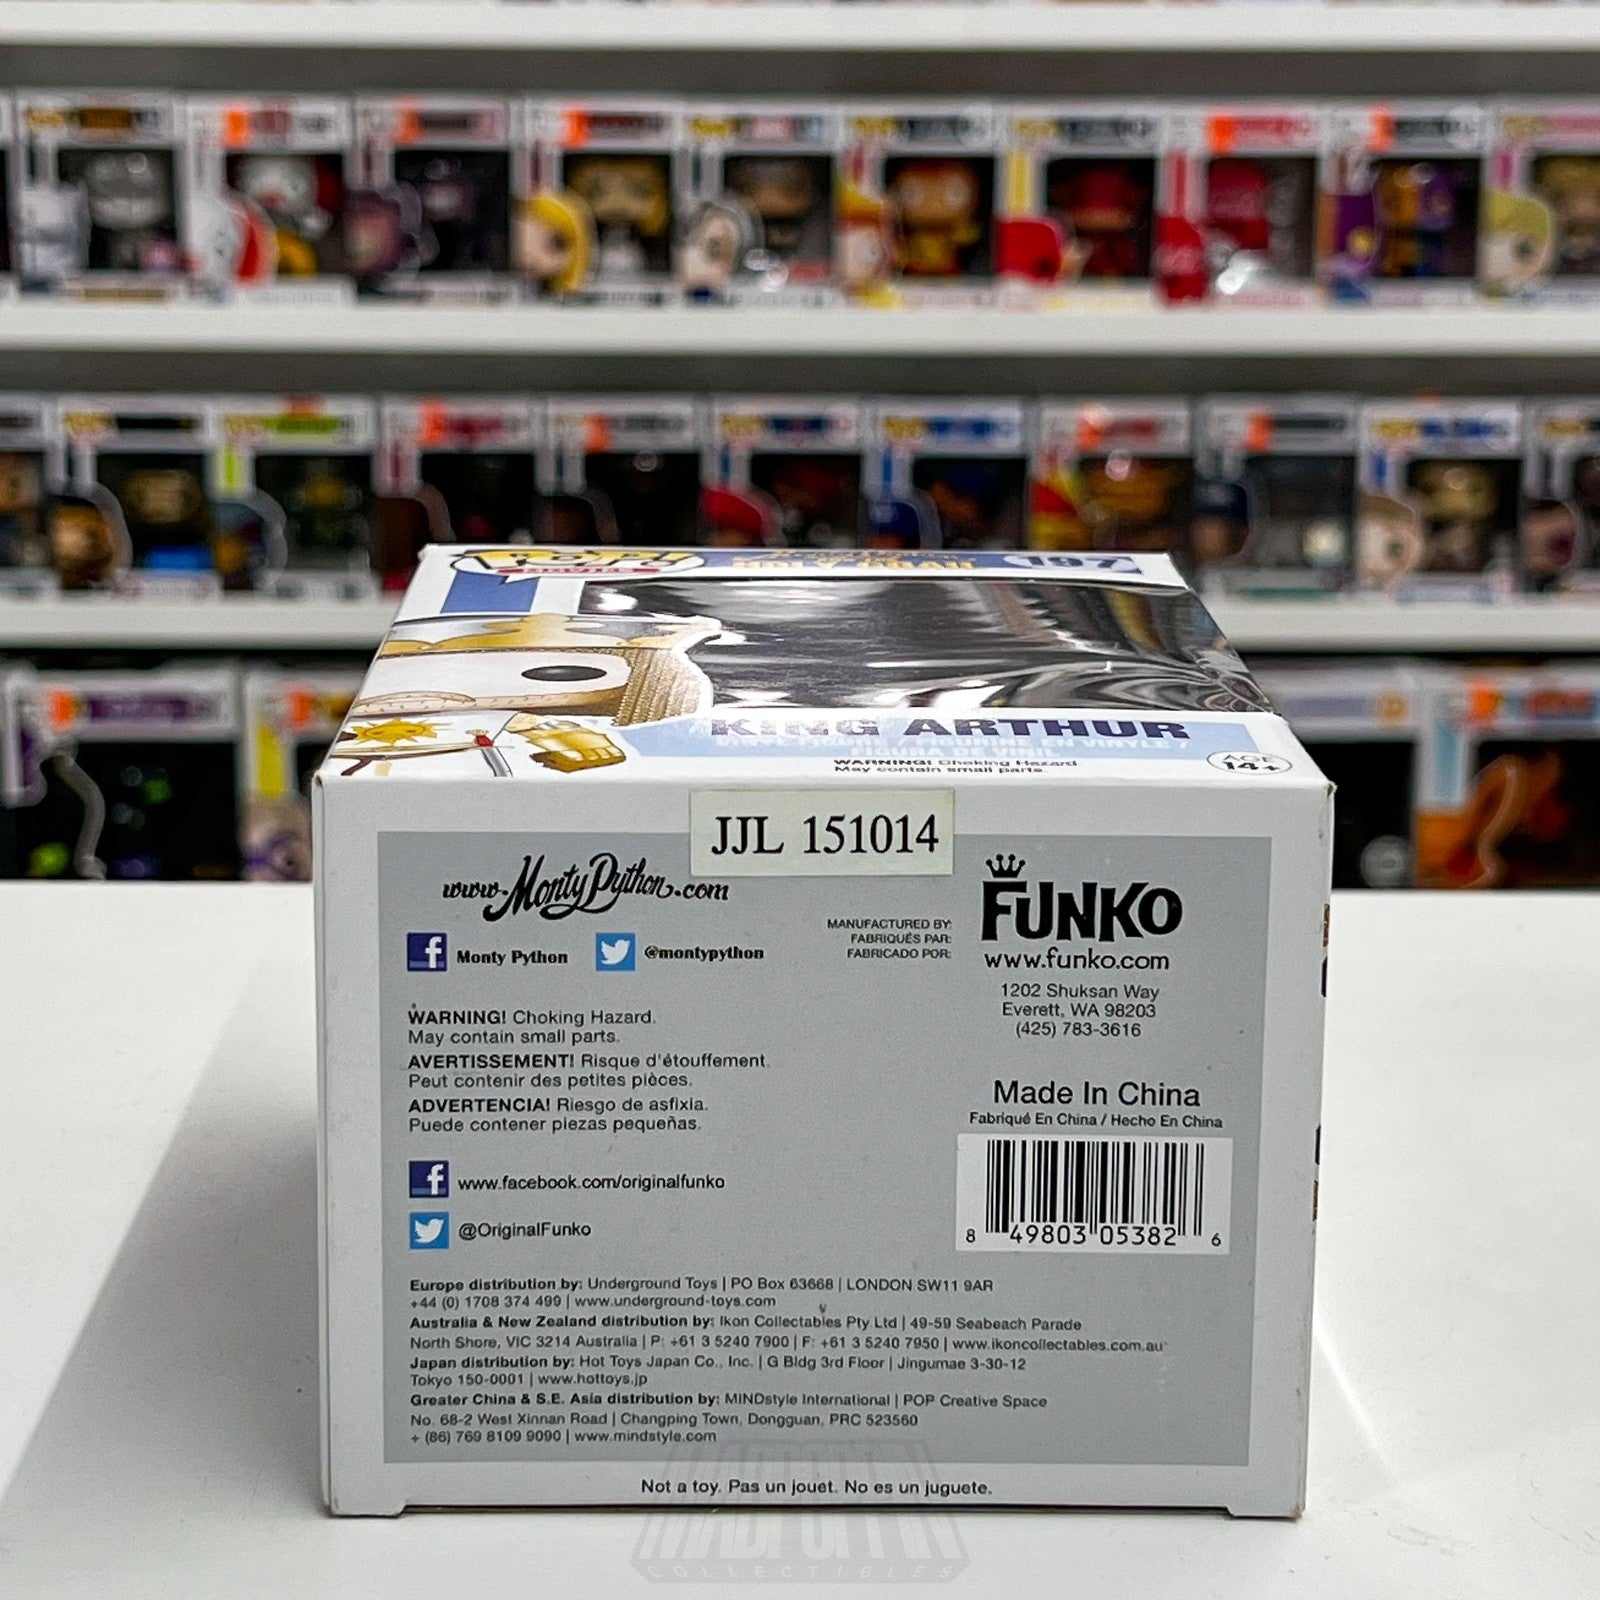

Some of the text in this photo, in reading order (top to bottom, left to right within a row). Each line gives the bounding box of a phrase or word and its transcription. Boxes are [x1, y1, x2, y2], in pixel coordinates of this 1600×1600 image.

[1022, 555, 1118, 569] 197
[711, 718, 1190, 740] KING ARTHUR
[712, 814, 939, 855] JJL 151014
[981, 881, 1182, 942] FUNKO
[827, 919, 952, 929] MANUFACTURED BY:
[851, 932, 951, 944] FABRIQUÉS PAR:
[457, 950, 567, 966] Monty Python
[645, 946, 764, 962] @montypython
[847, 948, 951, 959] FABRICADO POR:
[984, 946, 1169, 970] www.funko.com
[1002, 984, 1160, 1000] 1202 Shuksan Way
[408, 1010, 505, 1025] WARNING!
[513, 1010, 584, 1026] Choking
[1003, 1002, 1157, 1019] Everett, WA 98203
[409, 1029, 620, 1047] May contain small parts.
[1016, 1021, 1141, 1039] (425) 783-3616
[408, 1054, 574, 1069] AVERTISSEMENT!
[582, 1054, 640, 1070] Risque
[409, 1072, 692, 1090] Peut contenir des petites pièces.
[995, 1080, 1200, 1106] Made In China
[408, 1097, 707, 1115] ADVERTENCIA! Riesgo de asfixia.
[409, 1116, 700, 1134] Puede contener piezas pequeñas.
[970, 1112, 1223, 1128] Fabriqué En China Hecho En China
[458, 1173, 724, 1192] www.facebook.com/originalfunko
[459, 1222, 591, 1241] @OriginalFunko
[965, 1224, 1222, 1247] 8 49803 05382 6
[410, 1277, 993, 1293] Europe distribution by: Underground Toys PO Box LONDON SW11 9AR
[466, 1294, 776, 1309] 1708 www.underground-toys.com
[410, 1315, 1081, 1330] Australia New Zealand distribution by: Collectables 49-59 Seabeach Parade
[411, 1335, 1163, 1352] North Shore, 3214 Australia 5240 7900 5240 7950 www.ikoncollectables.com.au
[410, 1355, 1026, 1372] Japan distribution by: Toys Japan Bldg Floor Jingumae 3-30-12
[410, 1373, 647, 1389] Tokyo 150-0001 www.hottoys.jp
[411, 1392, 1047, 1409] Greater China Asia distribution by: MINDstyle International POP Creative Space
[477, 1412, 918, 1428] West Xinnan Road Changping Town, Dongguan, PRC 523560
[487, 1430, 716, 1443] 8109 9090 www.mindstyle.com
[642, 1479, 992, 1497] Not a toy. Pas un jouet. No es un juguete.
